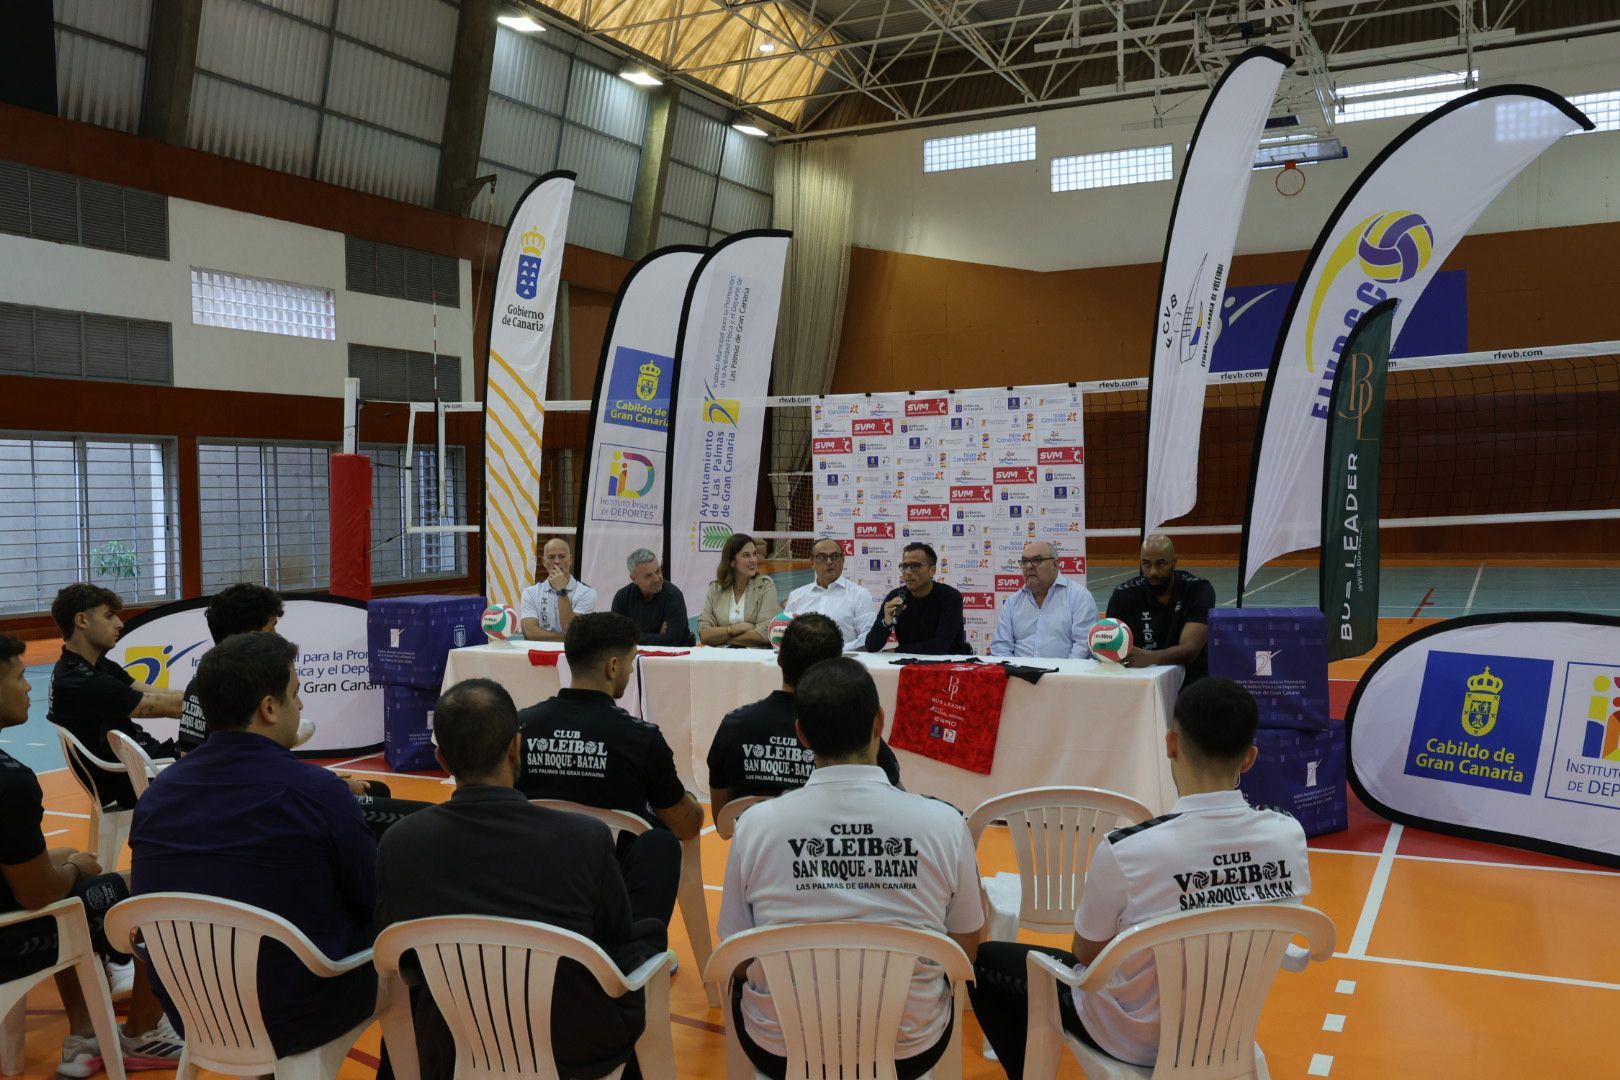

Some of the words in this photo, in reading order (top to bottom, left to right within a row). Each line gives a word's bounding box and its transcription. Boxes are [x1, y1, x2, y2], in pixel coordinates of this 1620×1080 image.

[502, 314, 511, 326] de
[508, 304, 544, 320] Gobierno
[736, 314, 745, 332] Gran
[735, 334, 741, 344] de
[731, 344, 740, 368] Palmas
[1494, 350, 1543, 359] rfevb.com
[1220, 370, 1262, 380] rfevb.com
[610, 409, 632, 420] Gran
[616, 400, 652, 414] Cabildo
[654, 408, 667, 416] de
[713, 431, 725, 471] Palmas
[724, 432, 735, 473] Canaria
[700, 430, 714, 516] Ayuntamiento
[711, 478, 720, 496] Las
[722, 476, 731, 502] Gran
[610, 508, 654, 520] DEPORTES
[710, 503, 719, 517] de
[721, 504, 730, 517] de
[1343, 453, 1359, 568] LEADER
[303, 653, 329, 664] para
[333, 651, 342, 660] la
[317, 667, 325, 678] y
[328, 665, 338, 675] el
[304, 682, 336, 693] Gran
[553, 730, 580, 738] CLUB
[769, 736, 797, 746] CLUB
[1426, 737, 1489, 761] Cabildo
[1493, 747, 1516, 765] de
[527, 753, 543, 765] SAN
[544, 753, 572, 769] ROQUE
[577, 756, 607, 770] BATAN
[744, 759, 759, 772] SAN
[760, 760, 790, 775] ROQUE
[1415, 753, 1455, 772] Gran
[1459, 759, 1524, 783] Canaria
[1566, 758, 1620, 779] INSTITUT
[1568, 781, 1583, 792] DE
[830, 824, 874, 835] CLUB
[1213, 851, 1252, 866] CLUB
[793, 860, 818, 878] SAN
[821, 860, 866, 880] ROQUE
[874, 860, 918, 877] BATAN
[1179, 892, 1205, 911] SAN
[1208, 886, 1250, 905] ROQUE
[1255, 880, 1295, 899] BATAN
